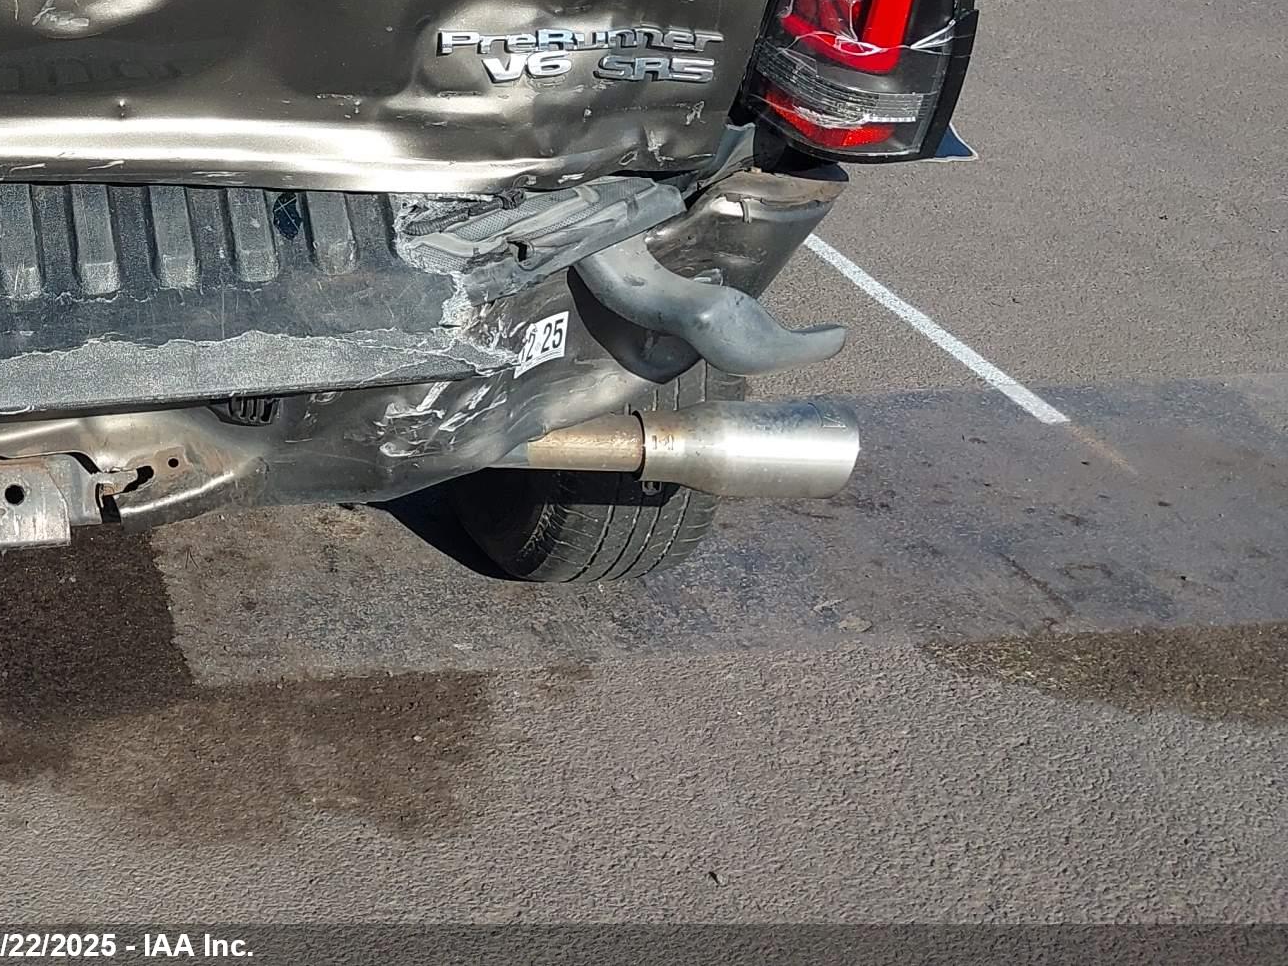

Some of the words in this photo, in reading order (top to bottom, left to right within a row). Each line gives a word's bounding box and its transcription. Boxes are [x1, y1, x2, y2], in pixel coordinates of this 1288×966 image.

[437, 25, 724, 56] PreRunner
[481, 50, 572, 84] V6
[593, 54, 715, 84] SR5
[540, 318, 564, 354] 25
